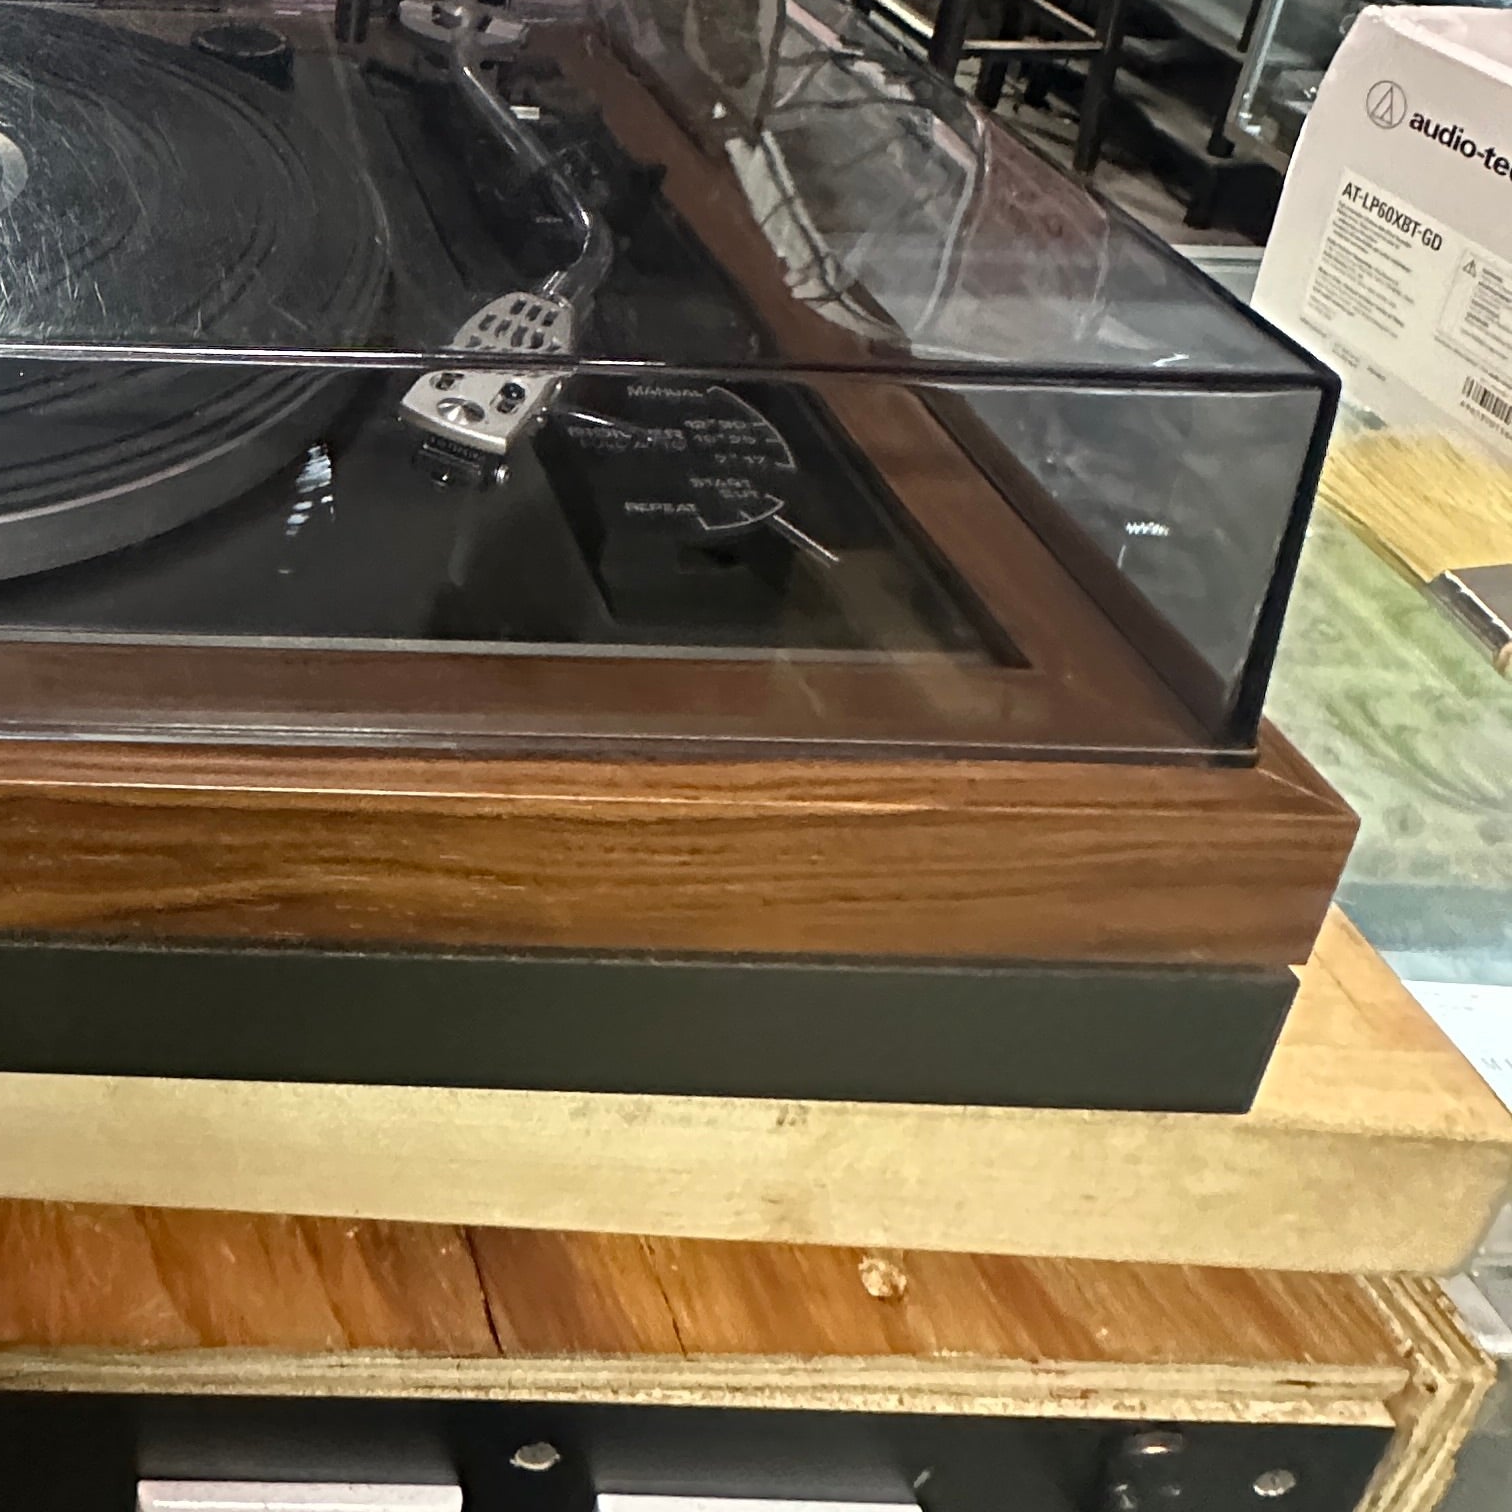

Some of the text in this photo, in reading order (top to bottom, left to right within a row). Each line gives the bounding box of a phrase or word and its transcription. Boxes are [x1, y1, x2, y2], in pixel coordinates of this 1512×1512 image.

[1408, 112, 1512, 183] audio-te
[1341, 181, 1443, 252] AT-LP60XBT-GD
[624, 501, 698, 513] REPEAT
